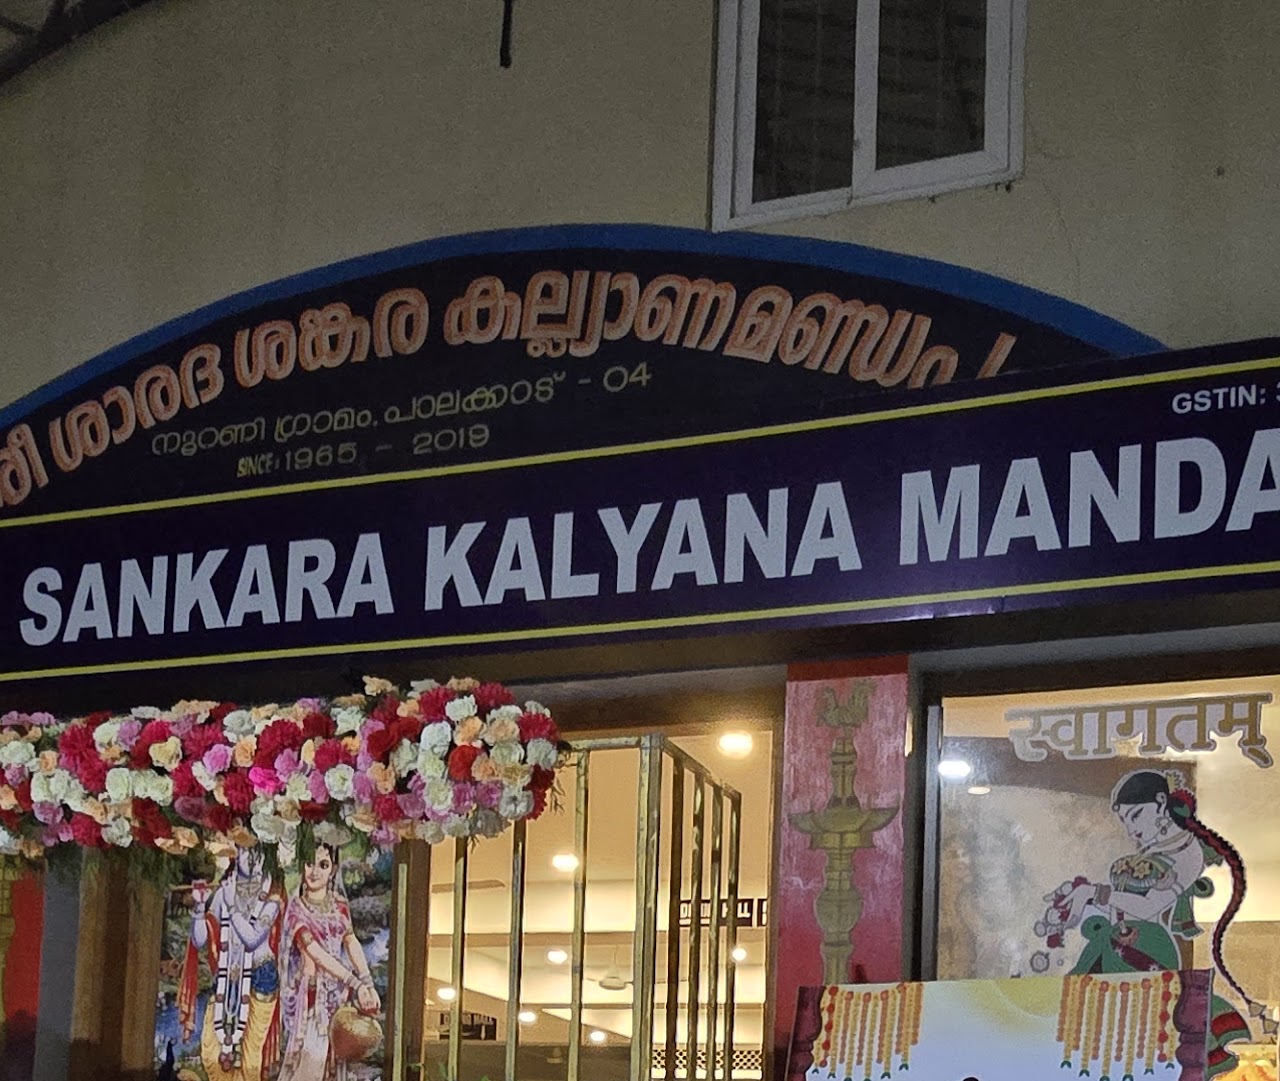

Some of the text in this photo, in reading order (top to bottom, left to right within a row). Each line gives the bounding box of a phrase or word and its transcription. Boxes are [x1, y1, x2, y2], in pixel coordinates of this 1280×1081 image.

[49, 343, 224, 472] ശാരദ
[235, 288, 430, 388] ശങ്കര
[384, 370, 566, 424] പാലക്കാട്
[602, 361, 652, 392] 04
[1172, 382, 1267, 415] GSTIN:
[285, 441, 357, 471] 1965
[412, 424, 490, 455] 2019
[19, 532, 394, 646] SANKARA
[423, 481, 861, 610] KALYANA
[1003, 690, 1274, 769] स्वागतम्
